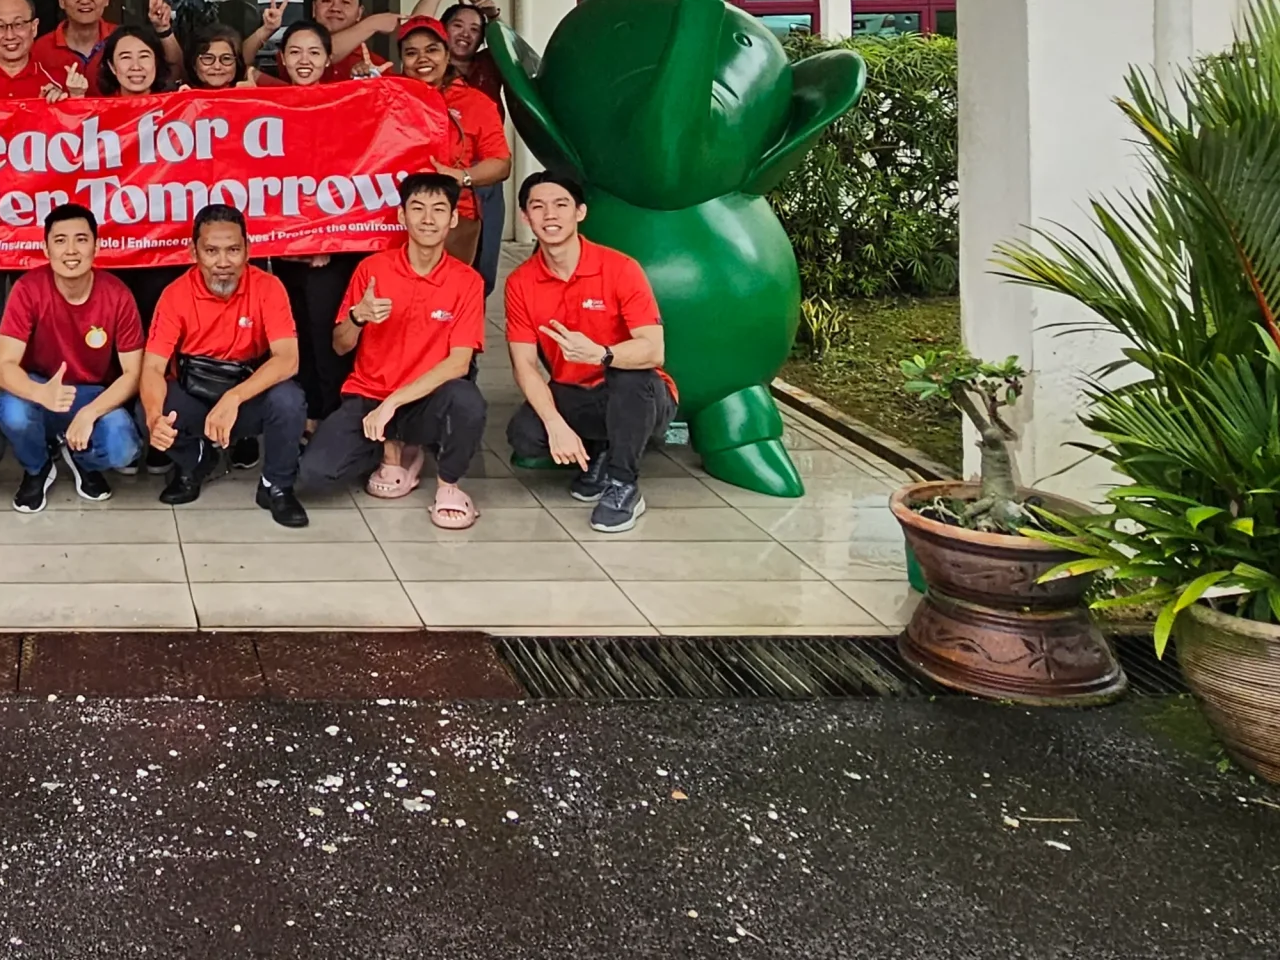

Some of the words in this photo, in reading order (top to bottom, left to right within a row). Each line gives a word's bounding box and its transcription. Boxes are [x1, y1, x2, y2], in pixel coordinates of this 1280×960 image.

[138, 110, 229, 164] for
[243, 115, 285, 158] a
[75, 170, 409, 225] Tomorrow
[127, 237, 179, 248] Enhance
[247, 231, 269, 243] ves
[277, 226, 323, 239] Protect
[326, 223, 347, 233] the
[348, 221, 407, 231] environm
